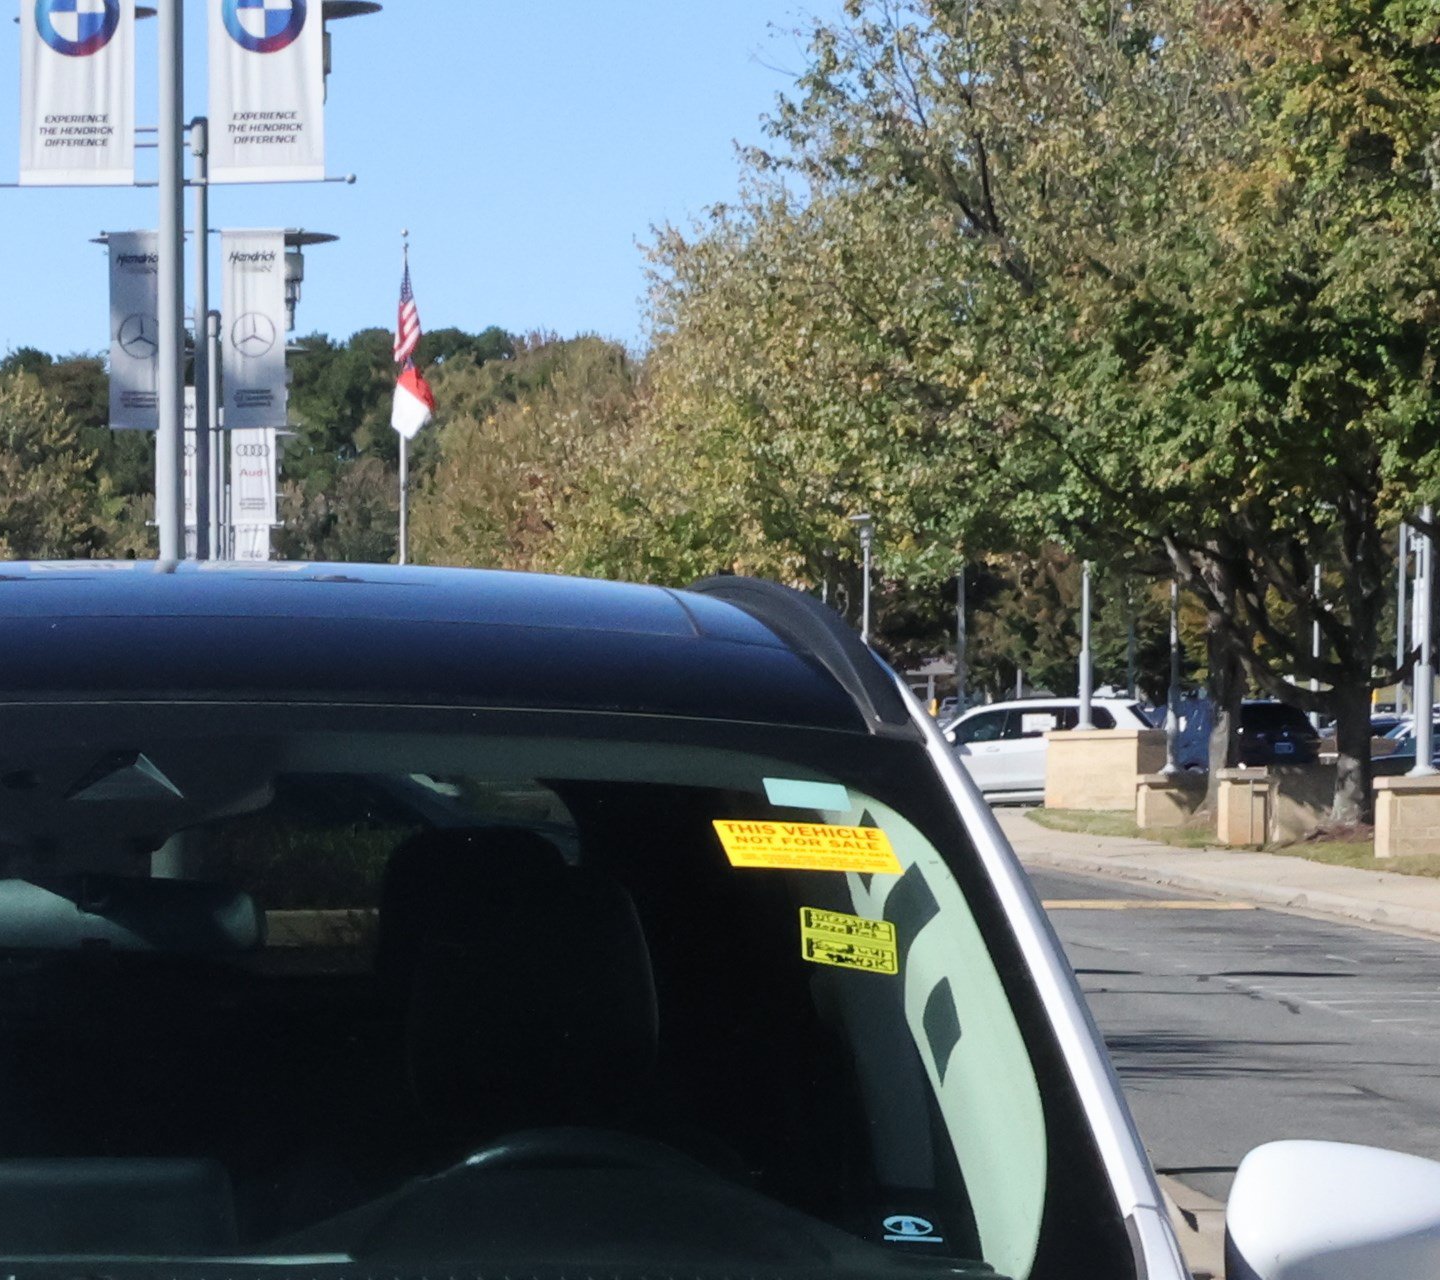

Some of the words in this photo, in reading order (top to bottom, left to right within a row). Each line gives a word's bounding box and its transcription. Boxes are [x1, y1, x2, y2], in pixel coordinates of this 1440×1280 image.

[44, 114, 109, 123] EXPERIENCE
[232, 111, 298, 120] EXPERIENCE
[39, 127, 58, 135] THE
[60, 126, 114, 135] HENDRICK
[228, 124, 247, 133] THE
[249, 123, 303, 132] HENDRICK
[44, 138, 109, 147] DIFFERENCE
[233, 135, 298, 144] DIFFERENCE
[229, 250, 276, 264] Hendrick
[239, 468, 269, 477] Audi
[724, 823, 776, 835] THIS
[782, 825, 881, 841] VEHICLE
[736, 836, 772, 844] NOT
[781, 837, 822, 847] FOR
[828, 840, 880, 851] SALE
